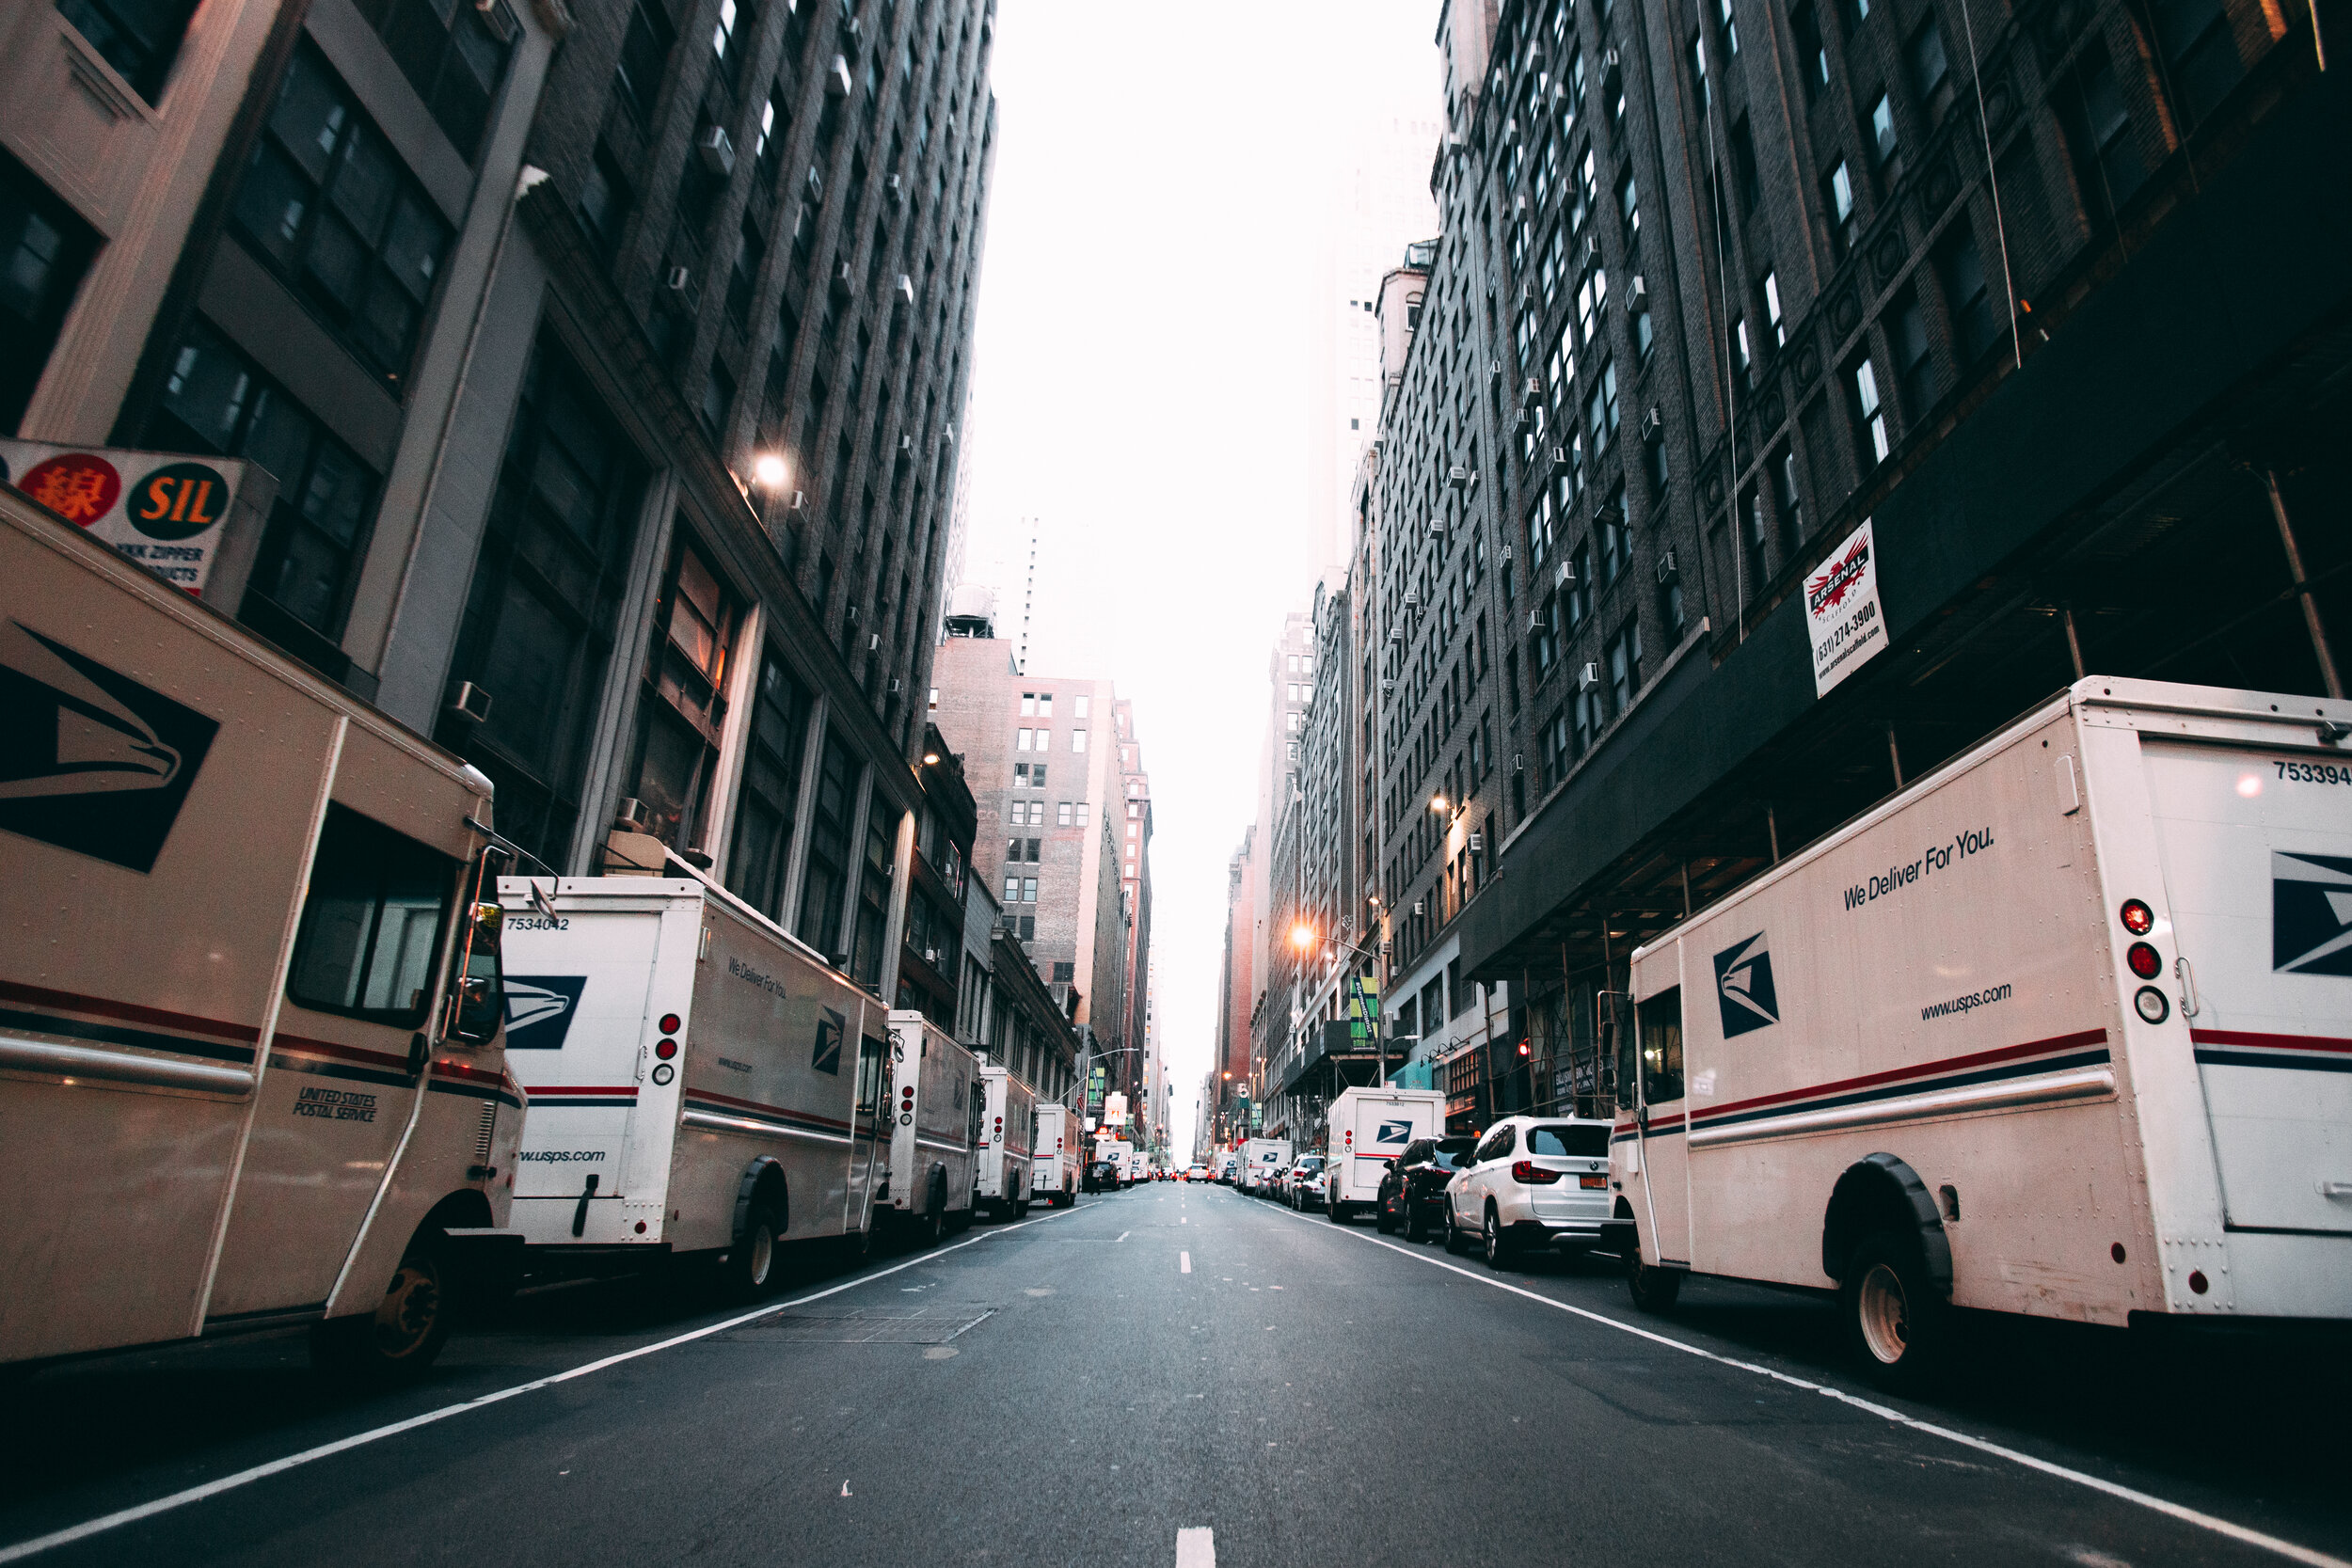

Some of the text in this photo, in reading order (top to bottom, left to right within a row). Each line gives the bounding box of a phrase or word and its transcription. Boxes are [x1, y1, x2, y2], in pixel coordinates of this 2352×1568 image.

[140, 476, 215, 524] SIL
[151, 545, 204, 562] ZIPPER
[1814, 555, 1866, 607] ARSENAL
[1821, 589, 1857, 625] SCAFFOLD
[1815, 600, 1876, 667] (631) 274-3900
[1818, 625, 1881, 680] www.arsenalscaffold.com
[2273, 760, 2352, 786] 753394
[1844, 827, 1994, 911] We Deliver For You.
[508, 917, 569, 930] 7534042
[728, 956, 740, 976] We
[740, 961, 765, 989] Deliver
[764, 975, 775, 992] For
[1920, 983, 2012, 1021] www.usps.com
[293, 1101, 376, 1122] POSTAL SERVICE
[298, 1086, 376, 1108] UNITED STATES
